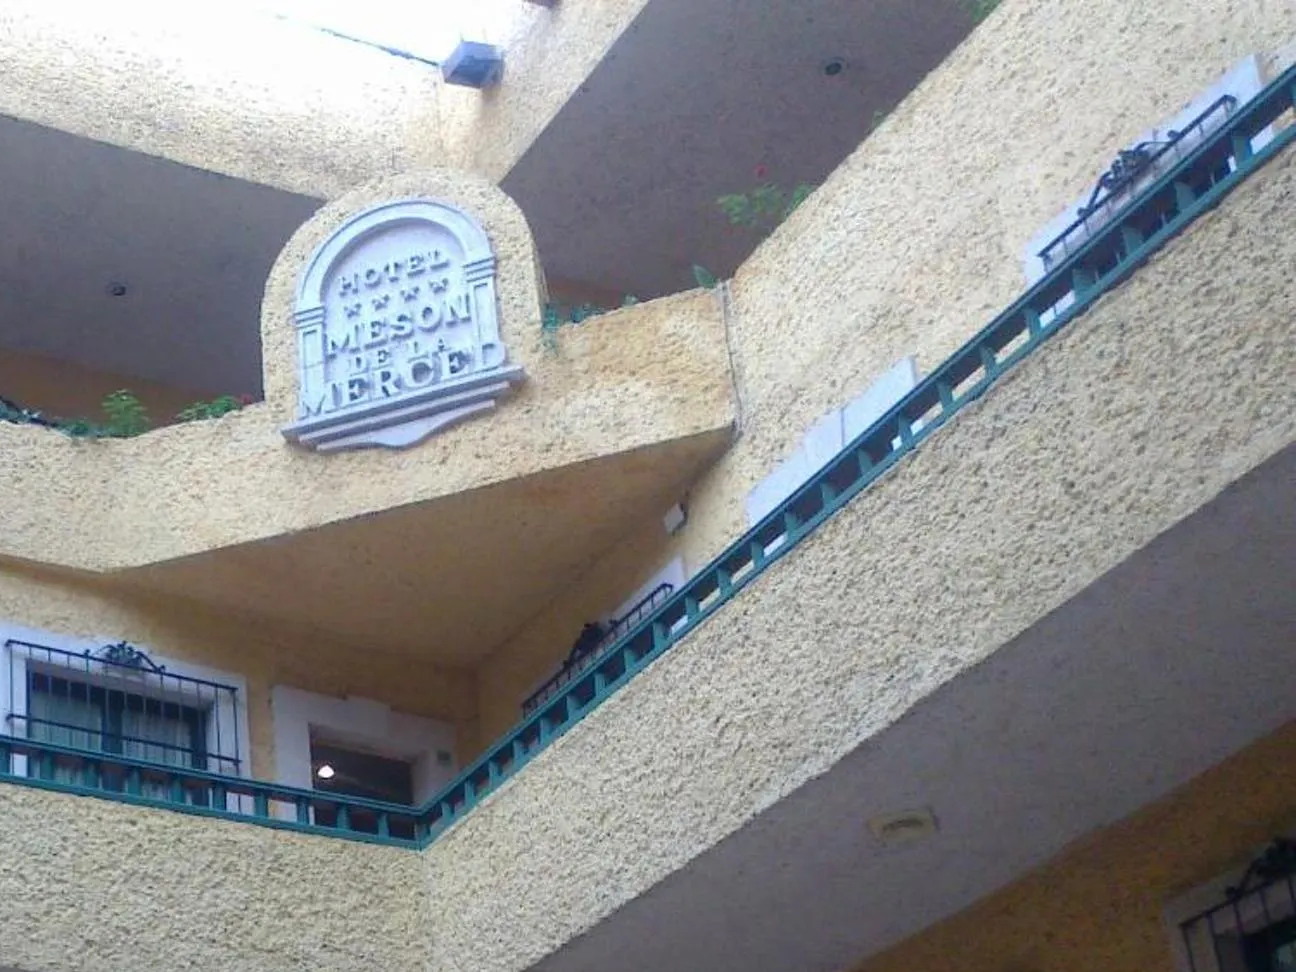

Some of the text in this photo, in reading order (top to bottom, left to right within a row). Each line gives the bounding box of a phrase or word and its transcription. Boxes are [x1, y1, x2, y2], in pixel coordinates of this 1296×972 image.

[339, 251, 449, 296] HOTEL
[325, 294, 473, 360] MESON
[349, 338, 451, 376] DE LA
